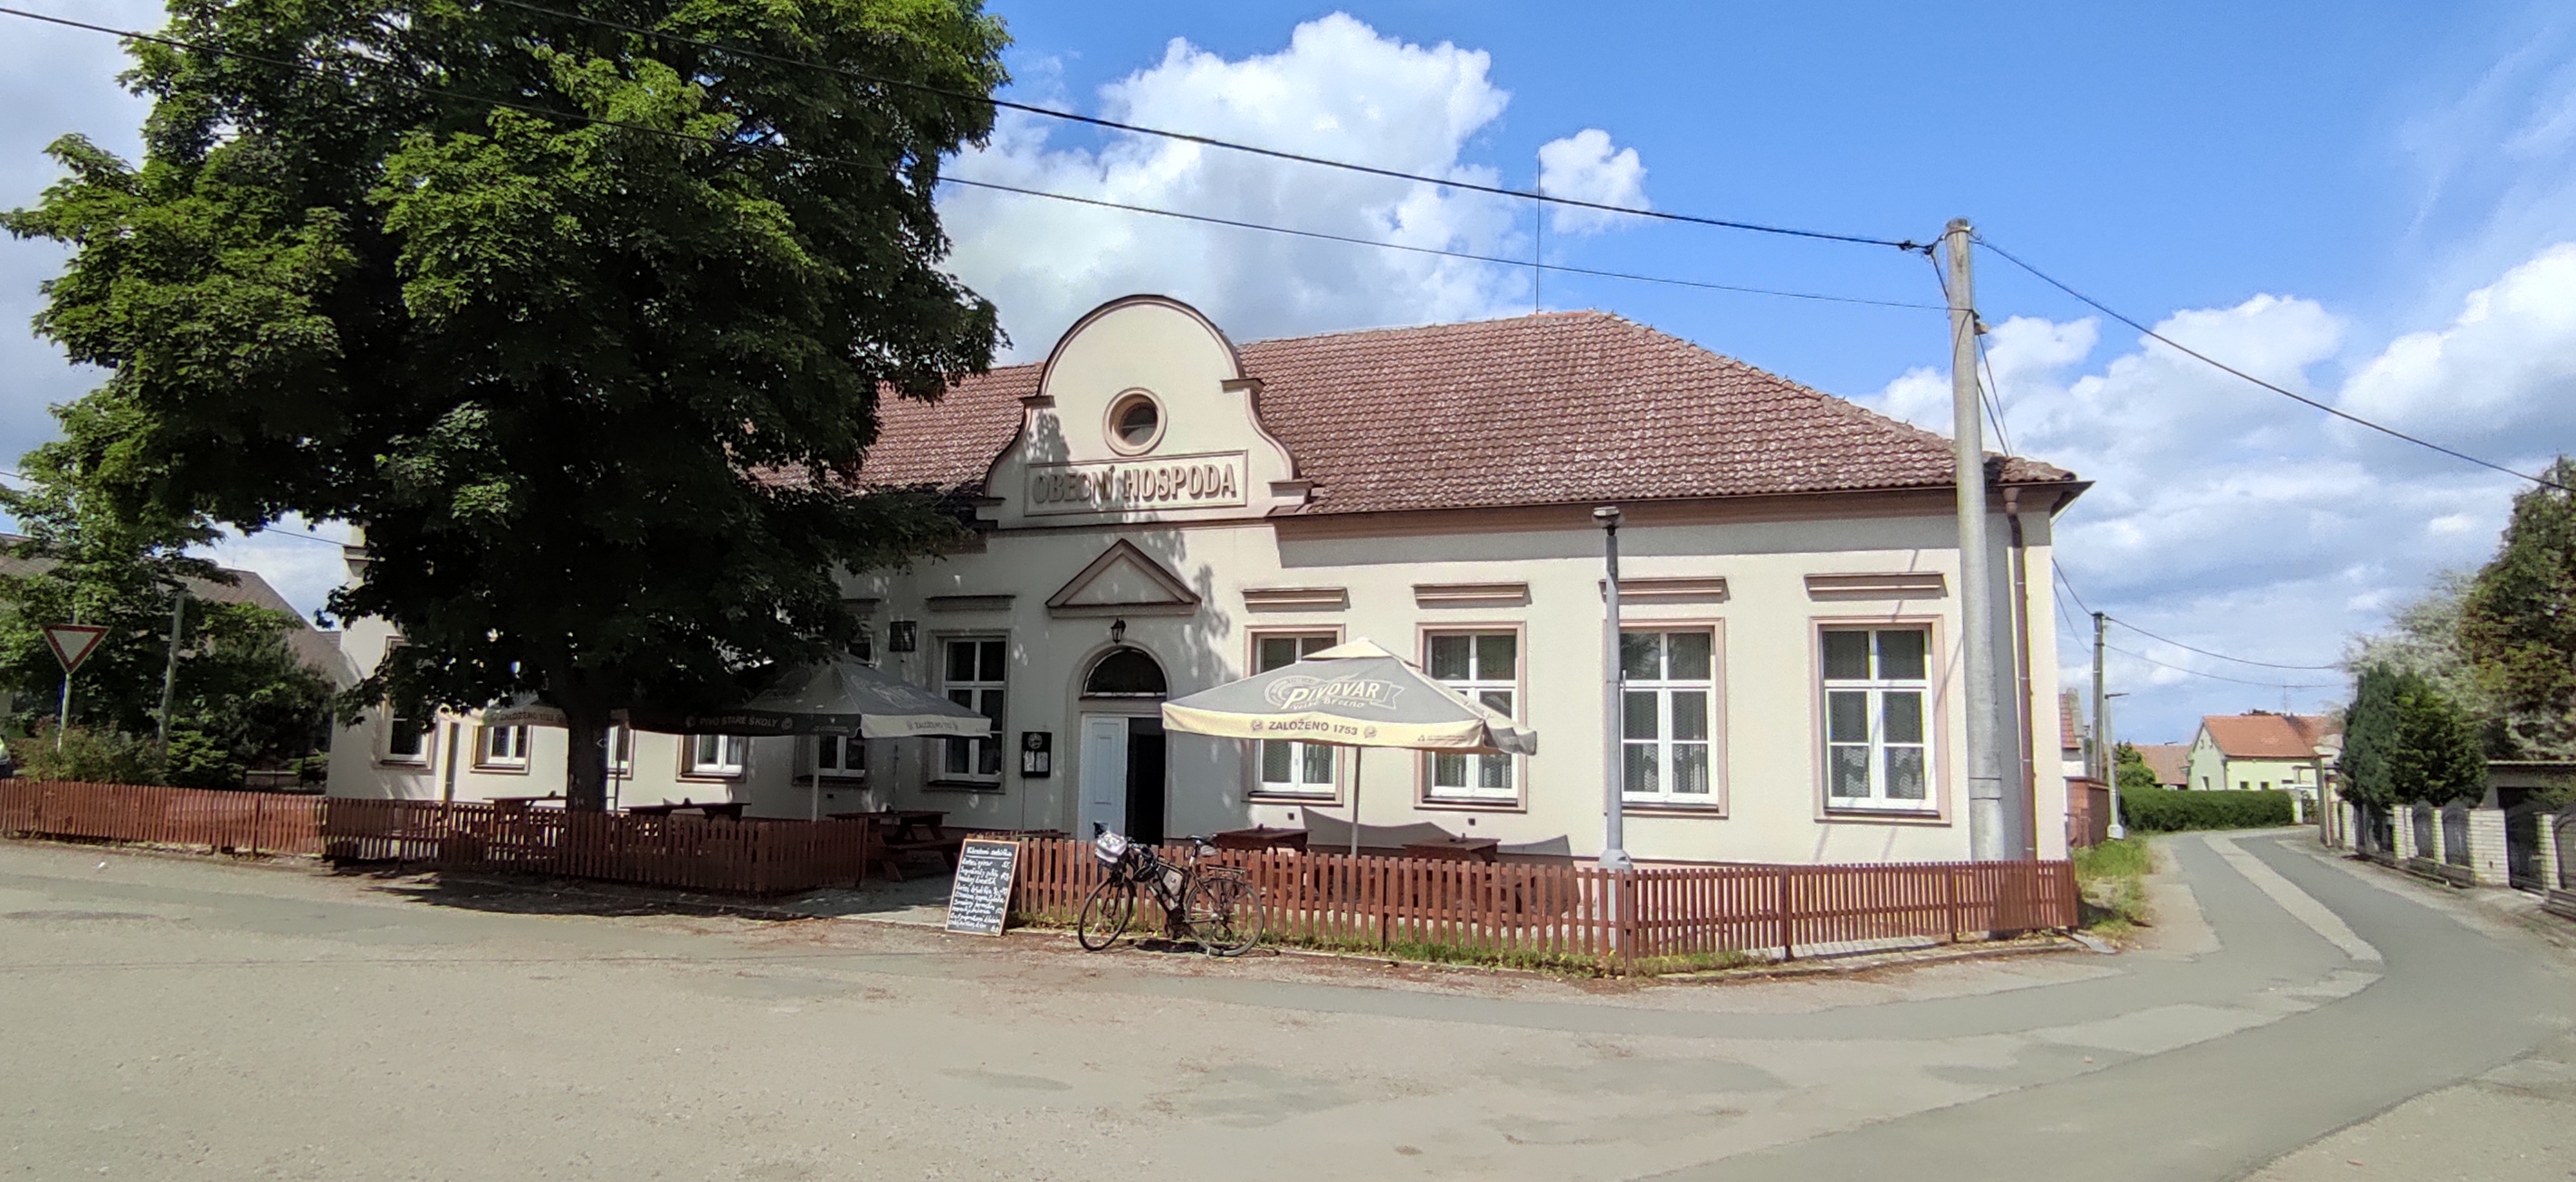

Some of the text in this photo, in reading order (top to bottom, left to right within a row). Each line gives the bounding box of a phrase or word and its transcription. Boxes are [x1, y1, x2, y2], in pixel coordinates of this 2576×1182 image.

[1032, 463, 1237, 503] OBECNÍ HOSPODA
[1281, 682, 1380, 710] PIVOVAR
[1269, 719, 1359, 736] ZALOŽENO 1753
